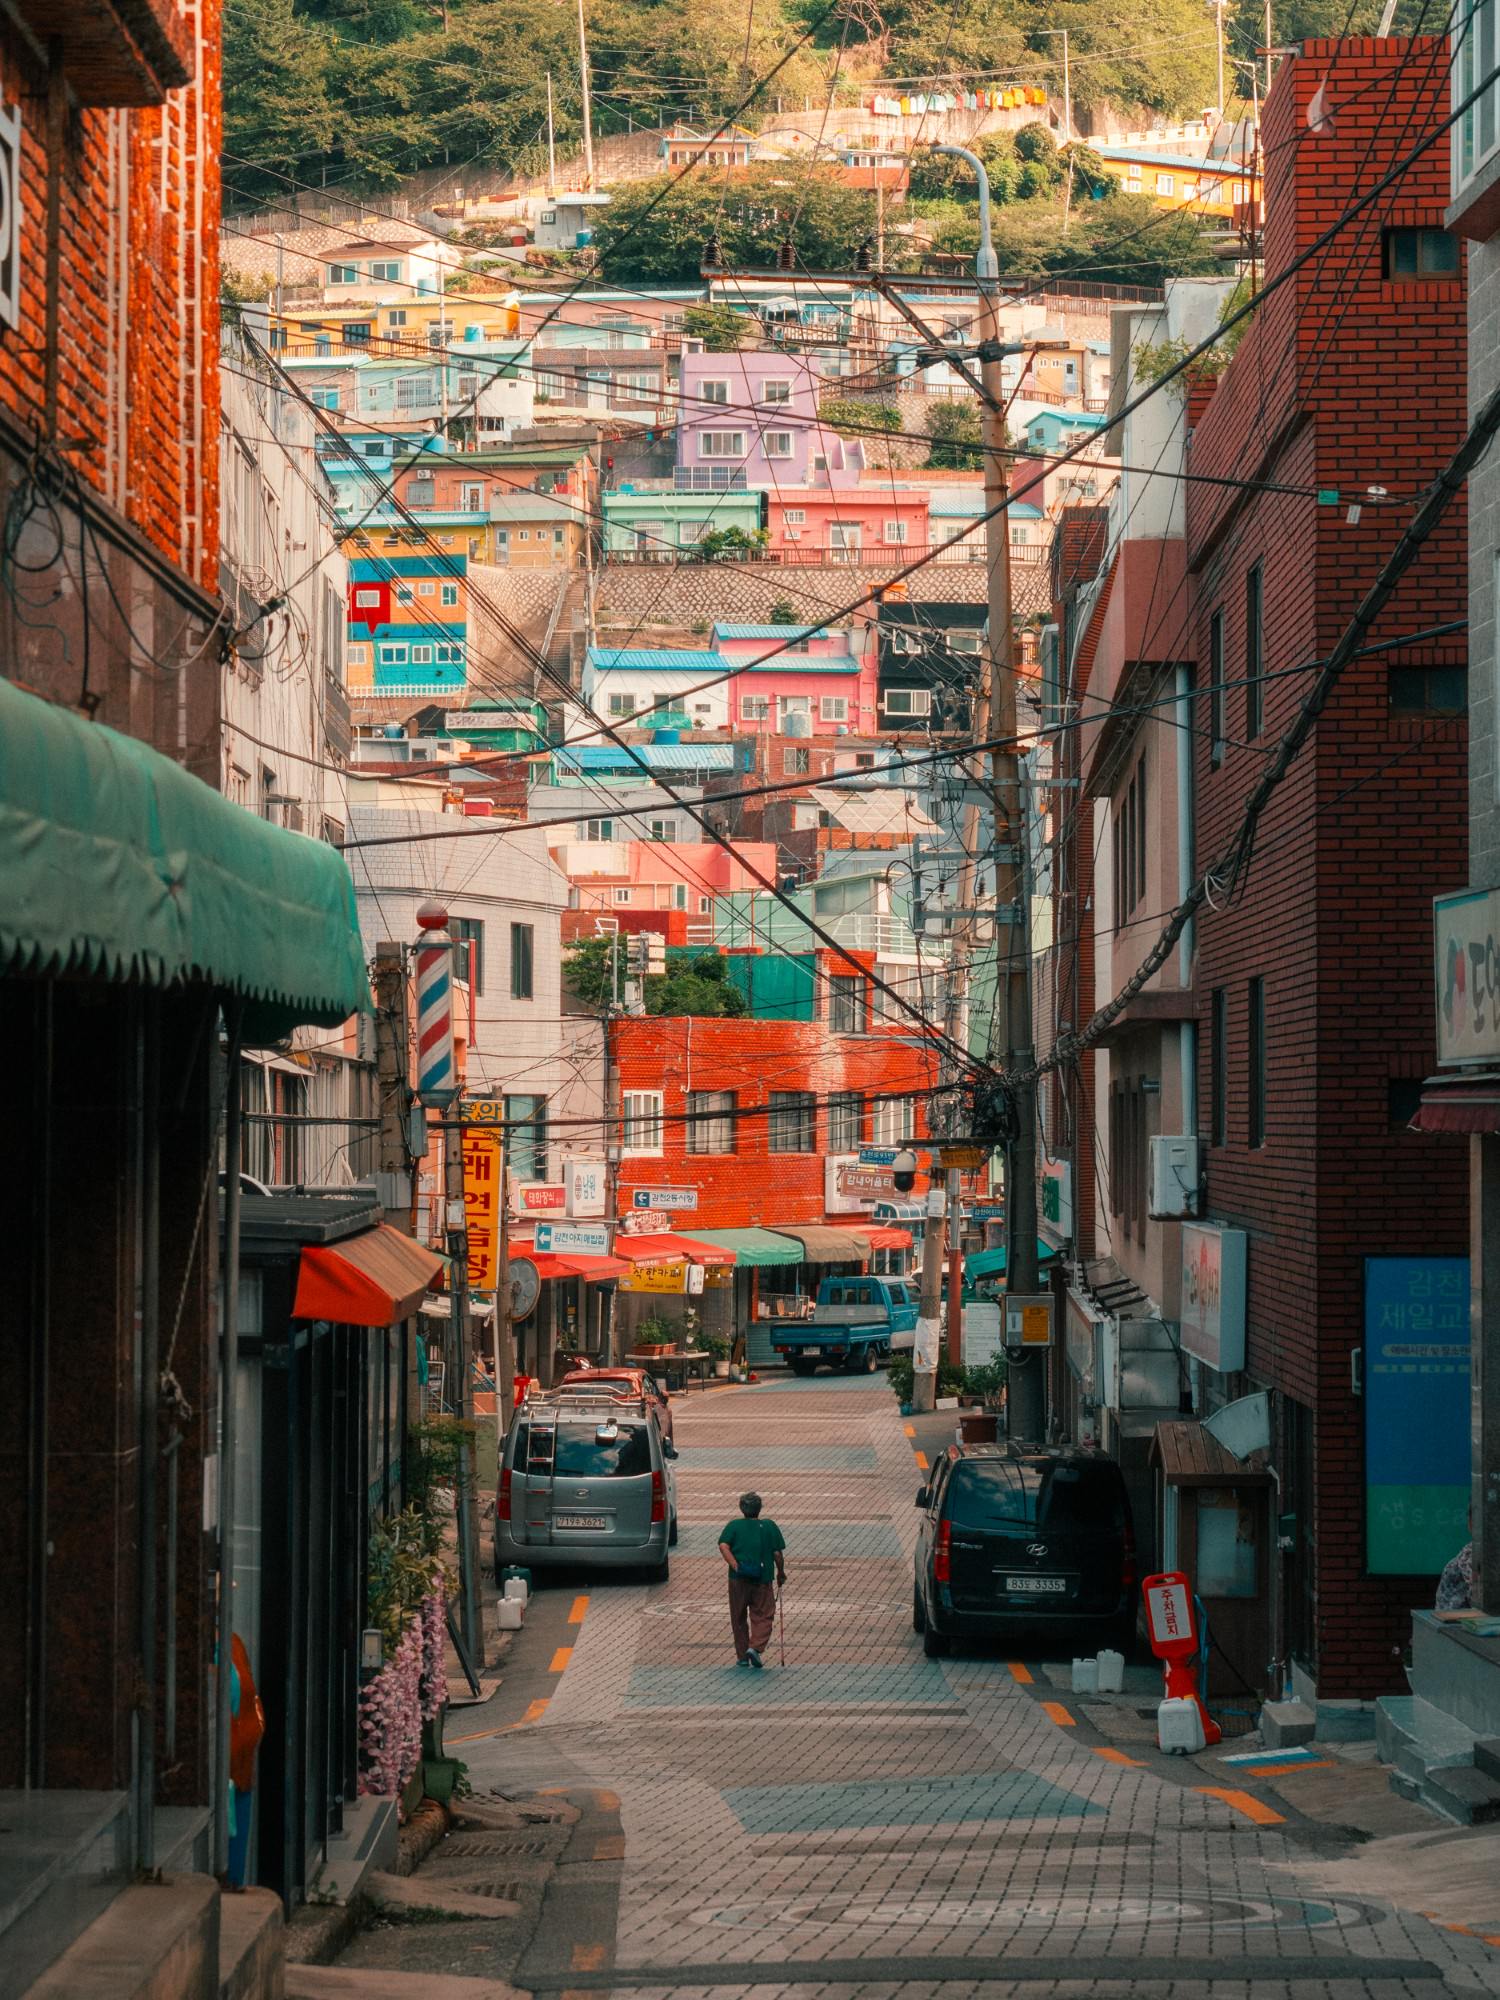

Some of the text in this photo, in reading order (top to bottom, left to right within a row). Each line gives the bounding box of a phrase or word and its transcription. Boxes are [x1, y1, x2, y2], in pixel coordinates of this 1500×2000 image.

[652, 1193, 694, 1204] 감천2동시장
[555, 1232, 605, 1245] 감천아지매밥집
[634, 1267, 682, 1281] 착한카페
[1407, 1269, 1462, 1297] 감천
[1379, 1303, 1471, 1330] 제일교
[1161, 1588, 1178, 1635] 주차금지
